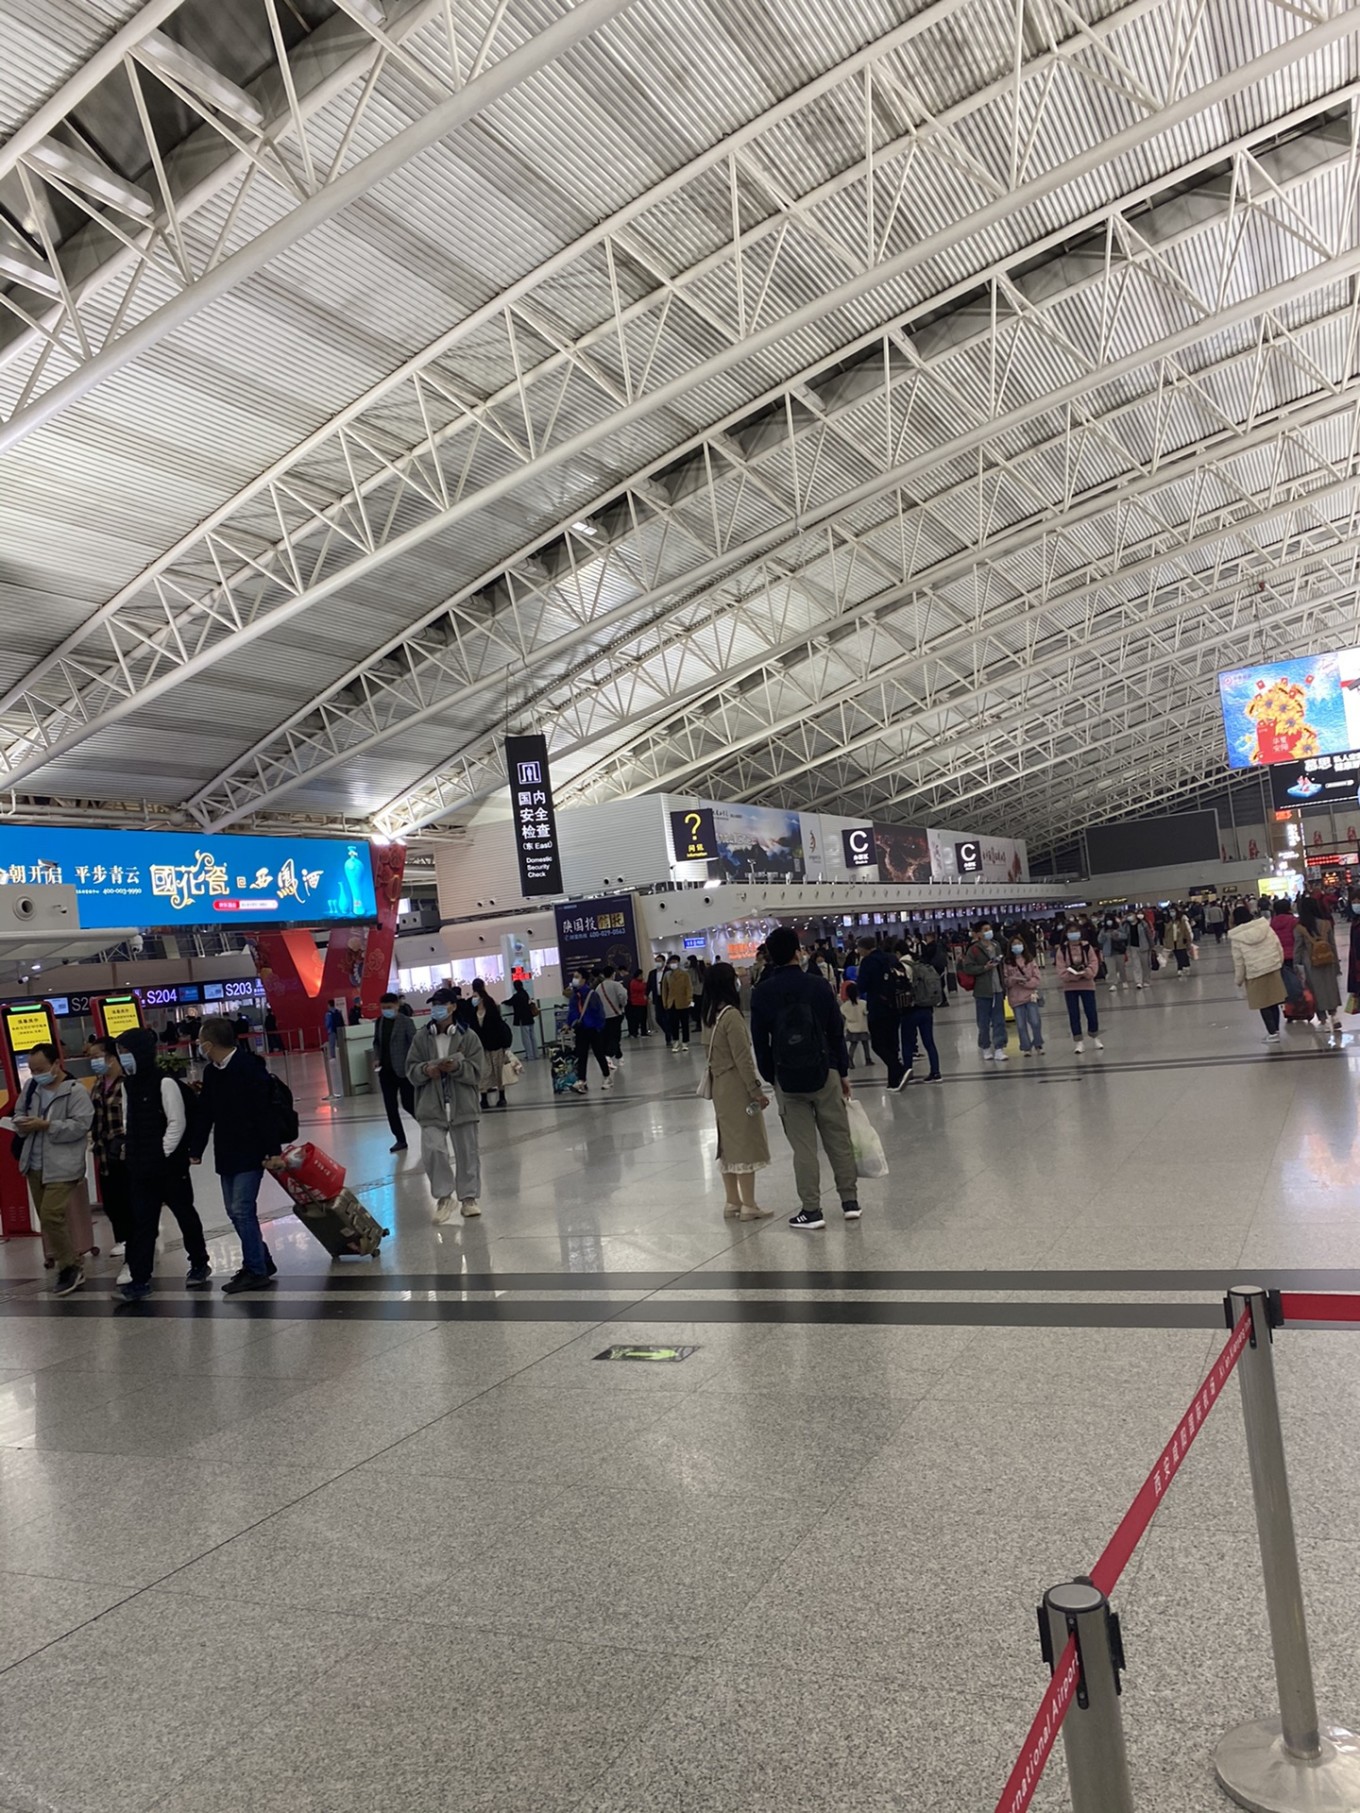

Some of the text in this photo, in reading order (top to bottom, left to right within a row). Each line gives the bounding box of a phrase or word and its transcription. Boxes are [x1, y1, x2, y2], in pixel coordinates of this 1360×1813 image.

[518, 790, 546, 806] 国内
[520, 807, 548, 823] 安全
[521, 823, 550, 840] 检查
[849, 830, 869, 853] C
[526, 856, 552, 864] Domestic
[960, 843, 977, 862] C
[75, 865, 141, 884] 平步青云
[146, 989, 178, 1005] S204
[225, 982, 253, 997] S203
[1052, 1651, 1079, 1723] Airport
